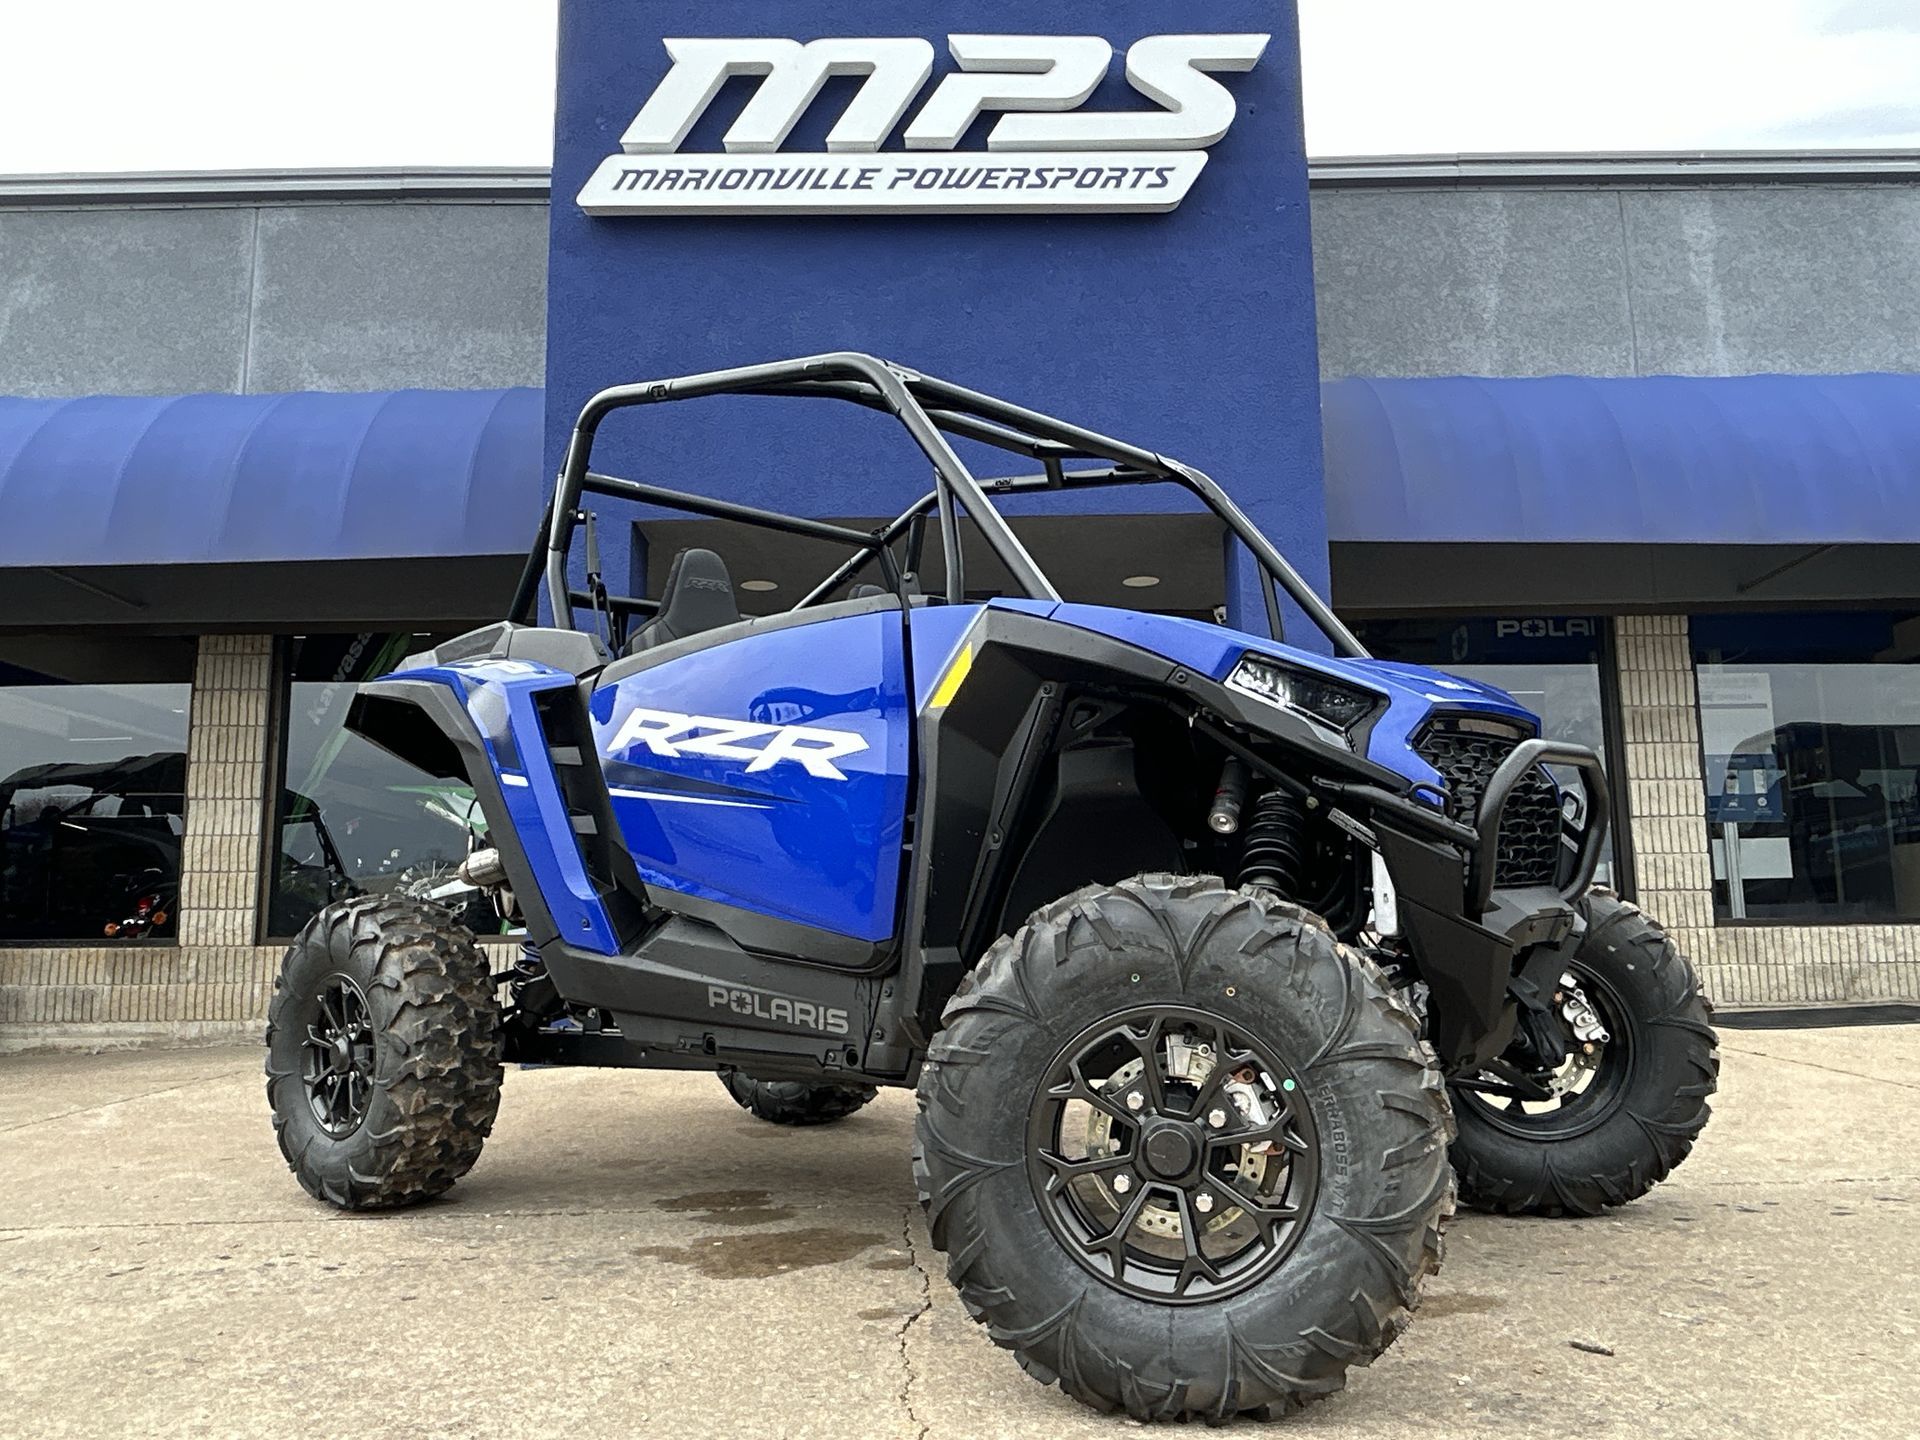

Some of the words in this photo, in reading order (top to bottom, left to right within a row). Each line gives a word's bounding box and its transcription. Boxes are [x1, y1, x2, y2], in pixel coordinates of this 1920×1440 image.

[620, 33, 1272, 152] MPS
[612, 168, 882, 190] MARIONVILLE
[888, 166, 1176, 189] POWERSPORTS
[1496, 619, 1595, 637] POLA
[607, 707, 870, 780] RZR
[708, 985, 849, 1034] POLARIS
